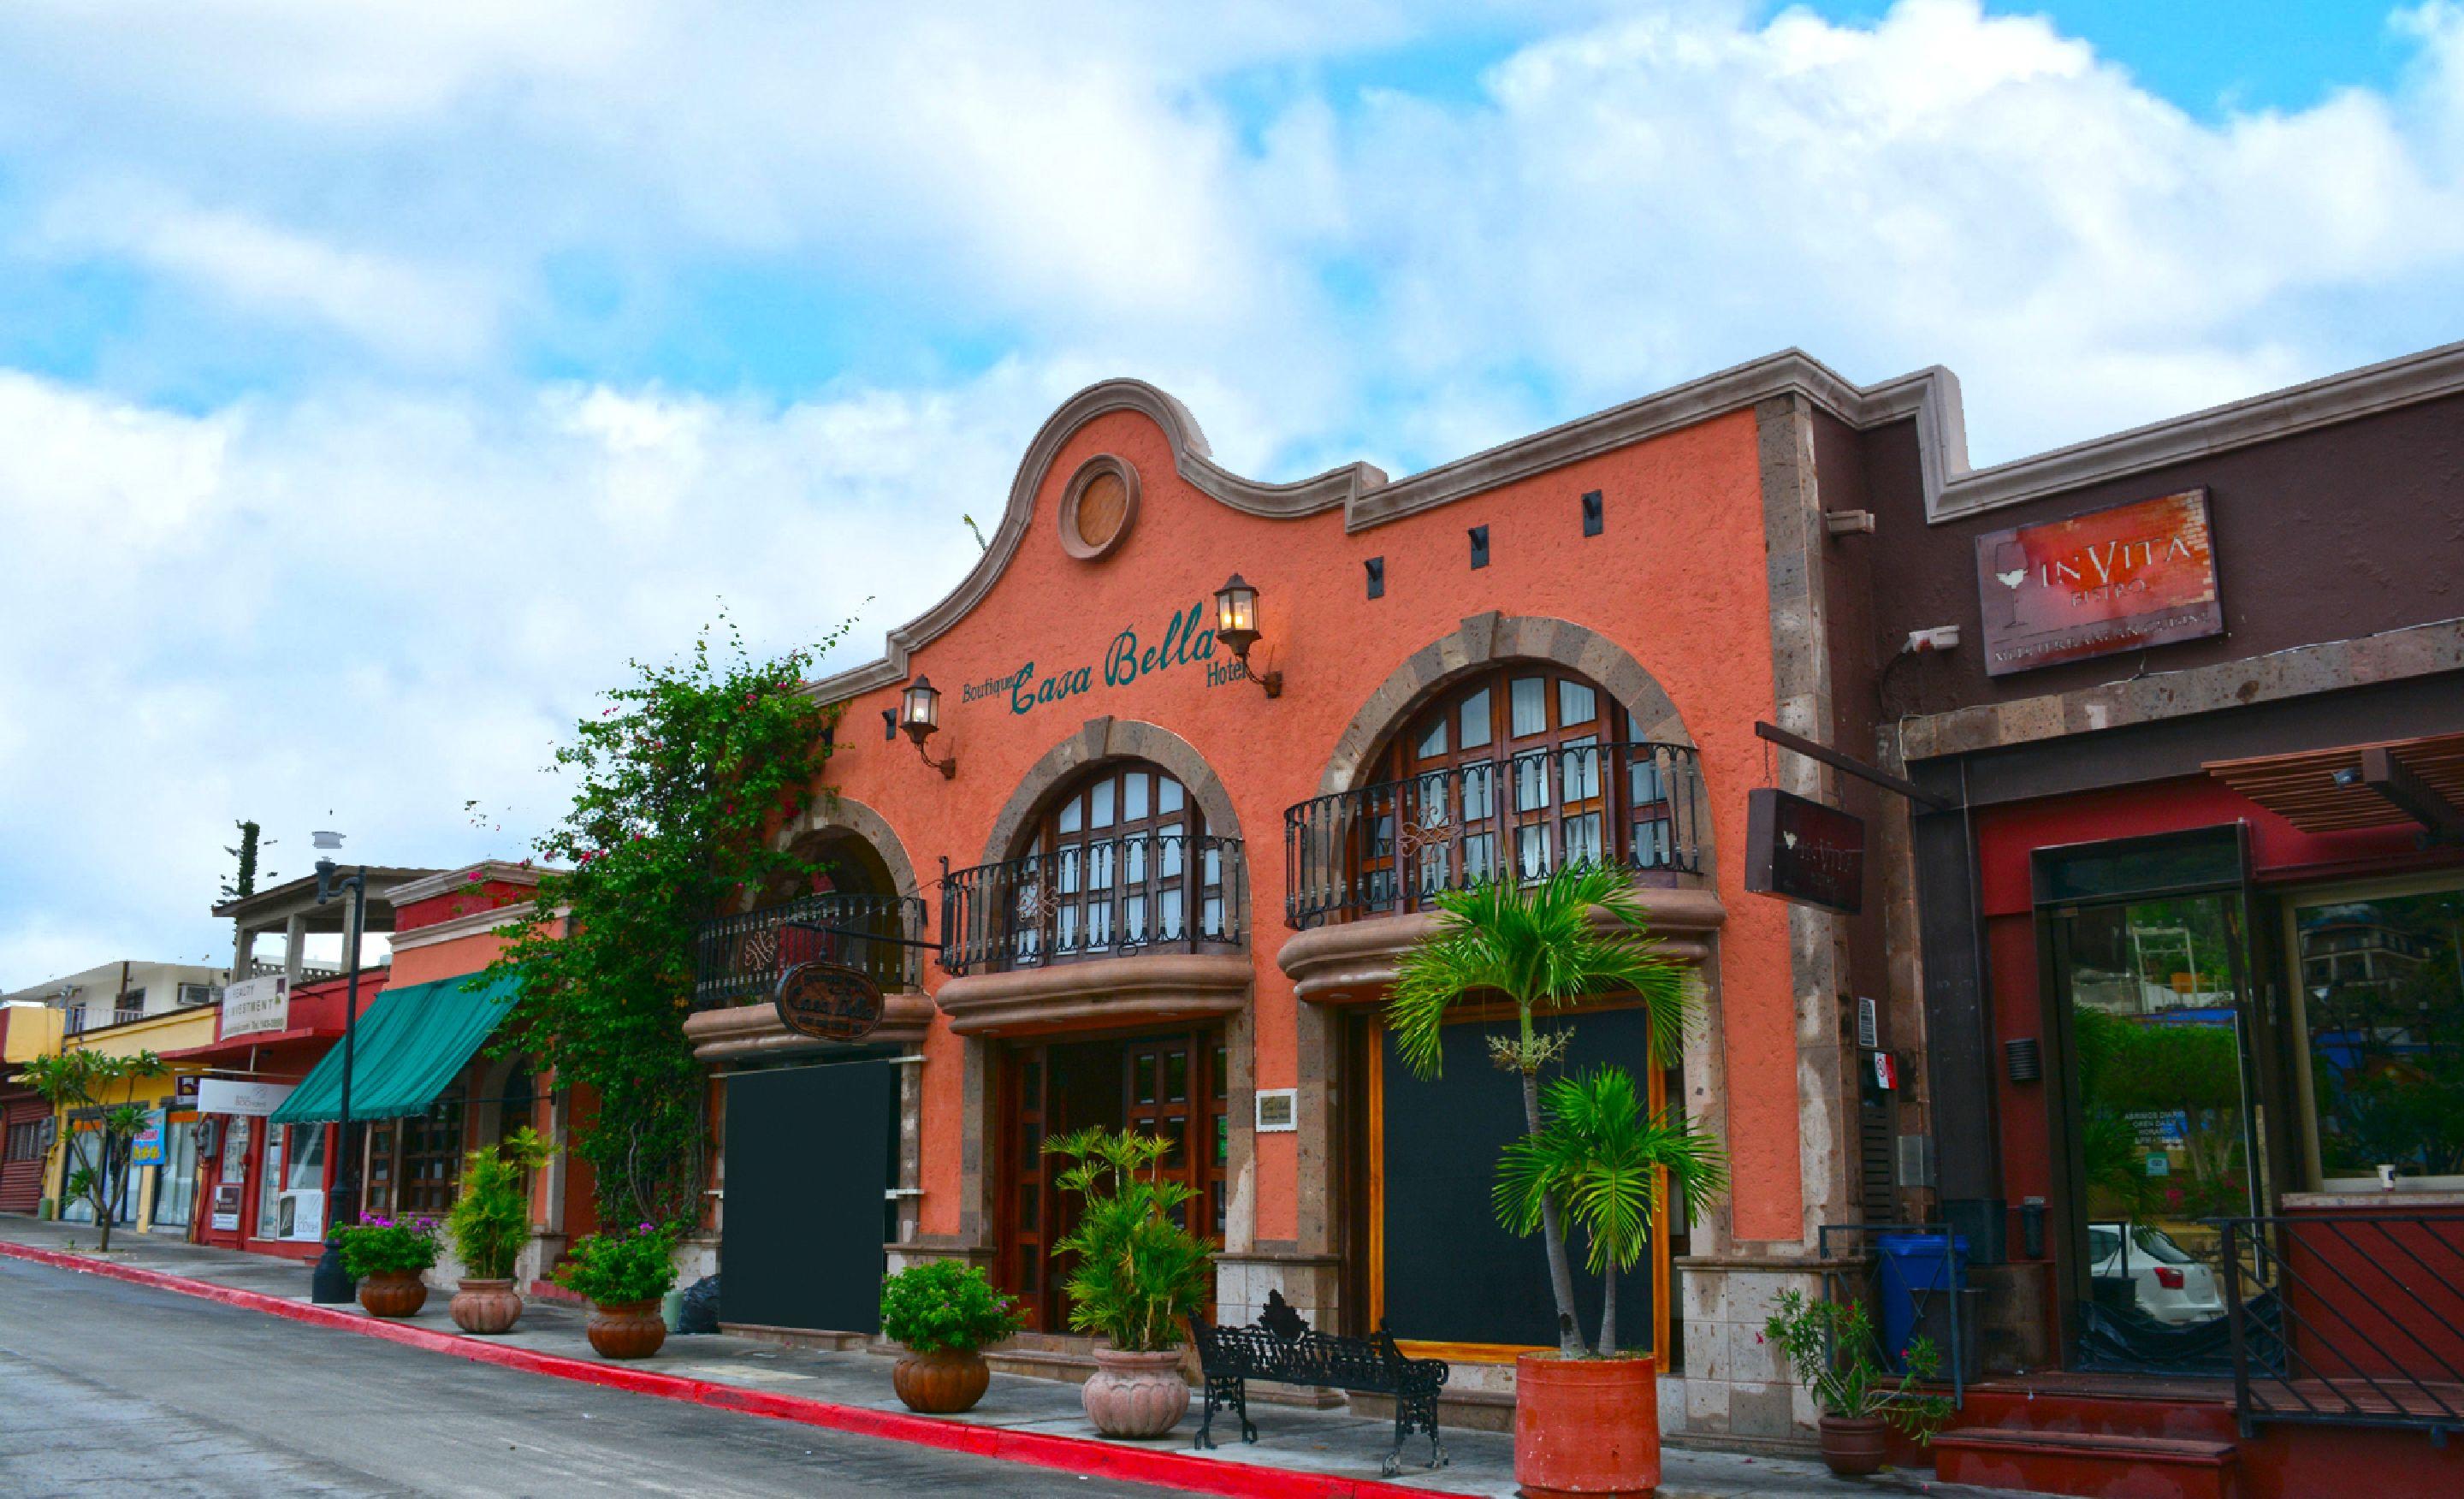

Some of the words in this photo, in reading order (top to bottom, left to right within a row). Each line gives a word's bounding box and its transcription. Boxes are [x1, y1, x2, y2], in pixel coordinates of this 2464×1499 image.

[2039, 535, 2191, 588] INVITA
[2071, 578, 2147, 607] BISTRO
[1009, 661, 1093, 715] Casa
[1104, 601, 1217, 686] Bella
[962, 675, 1015, 703] Boutique
